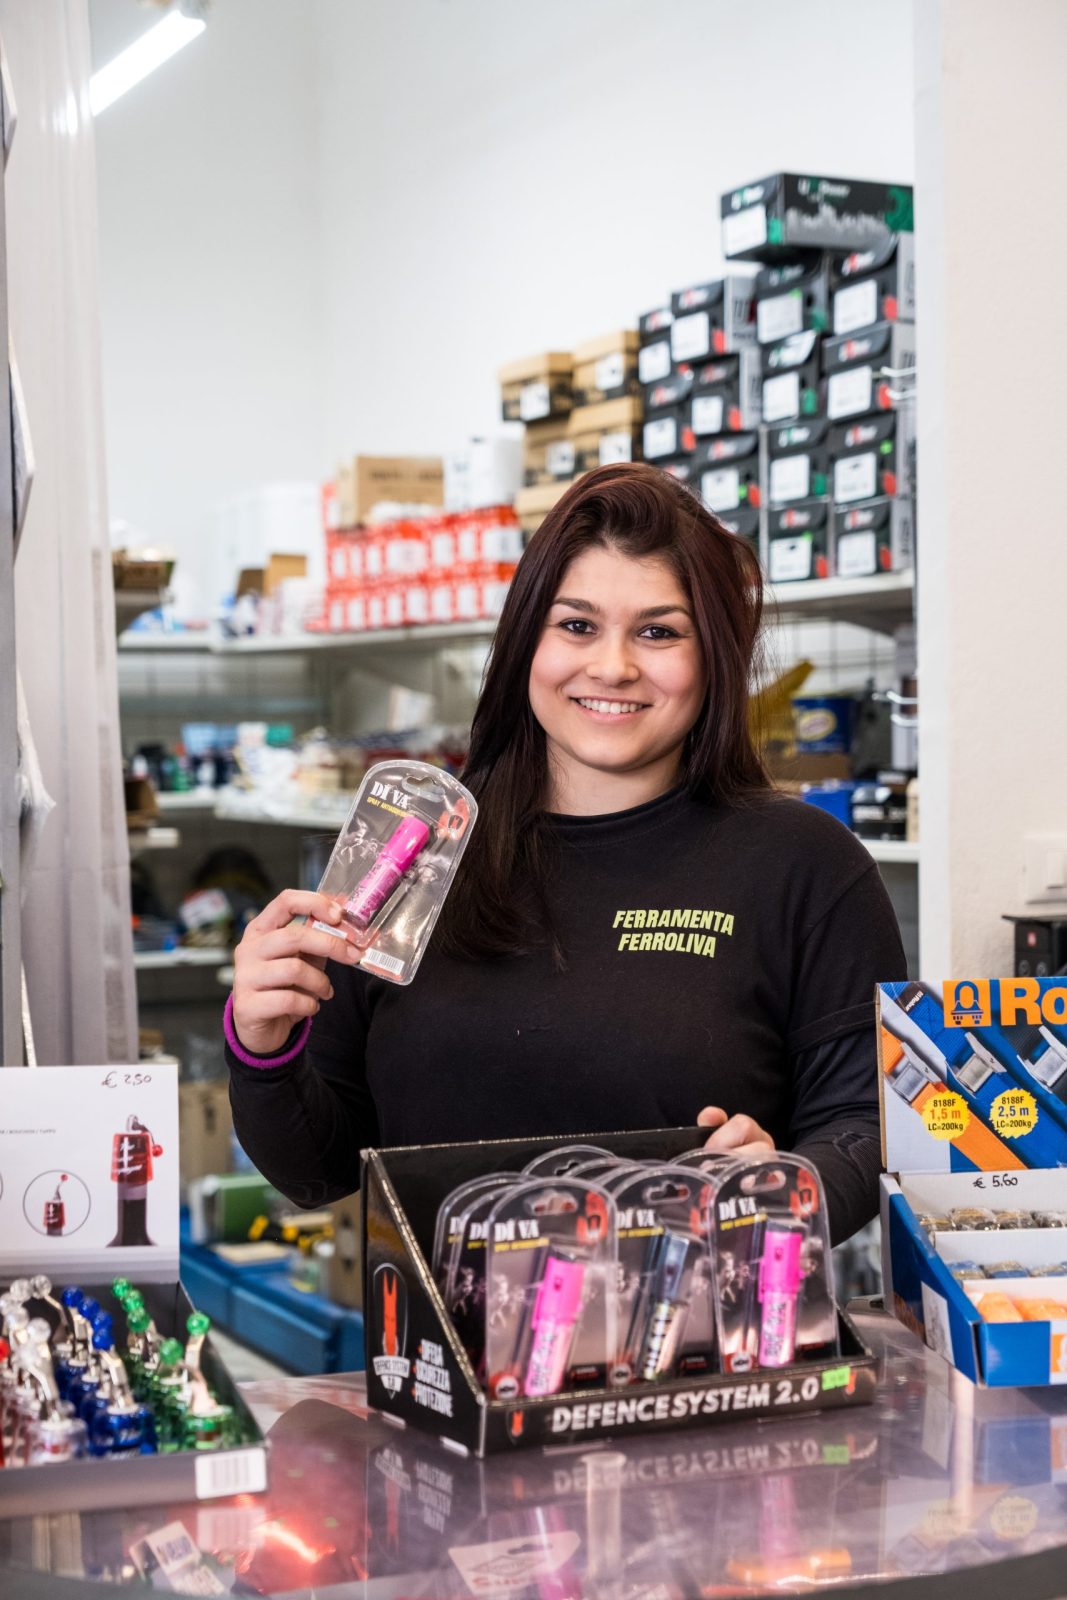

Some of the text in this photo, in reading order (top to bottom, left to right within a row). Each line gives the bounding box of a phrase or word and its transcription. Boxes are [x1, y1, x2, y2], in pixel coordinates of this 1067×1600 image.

[612, 909, 735, 936] FERRAMENTA
[617, 932, 717, 958] FERROLIVA
[1000, 978, 1067, 1026] Ro
[933, 1099, 956, 1108] 8188F
[1001, 1096, 1025, 1105] 8188F
[930, 1109, 961, 1120] 1,5 m
[998, 1106, 1029, 1118] 2,5 m
[928, 1123, 964, 1131] LC=200kg
[996, 1120, 1032, 1128] LC=200kg
[551, 1397, 671, 1433] DEFENCE
[671, 1383, 770, 1419] SYSTEM
[774, 1376, 820, 1405] 2.0
